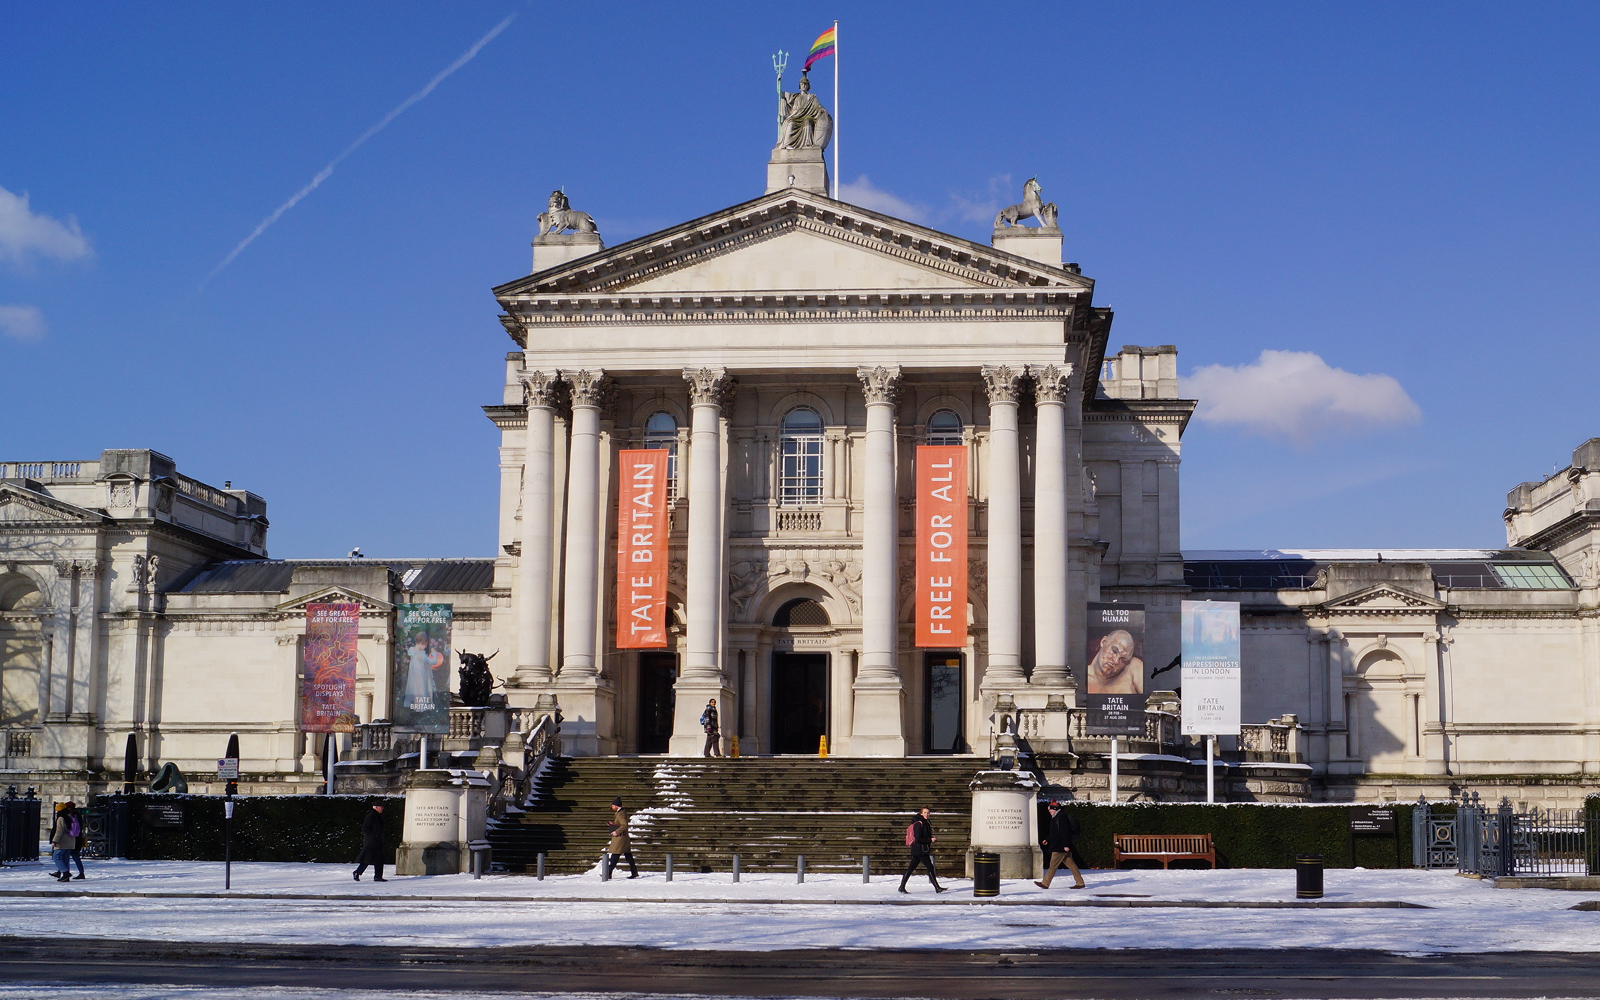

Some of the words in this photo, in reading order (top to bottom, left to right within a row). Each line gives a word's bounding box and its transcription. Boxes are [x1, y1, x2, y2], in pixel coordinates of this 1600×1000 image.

[931, 457, 953, 502] ALL
[632, 464, 654, 562] BRITAIN
[931, 514, 952, 562] FOR
[631, 576, 652, 635] TATE
[931, 576, 952, 634] FREE
